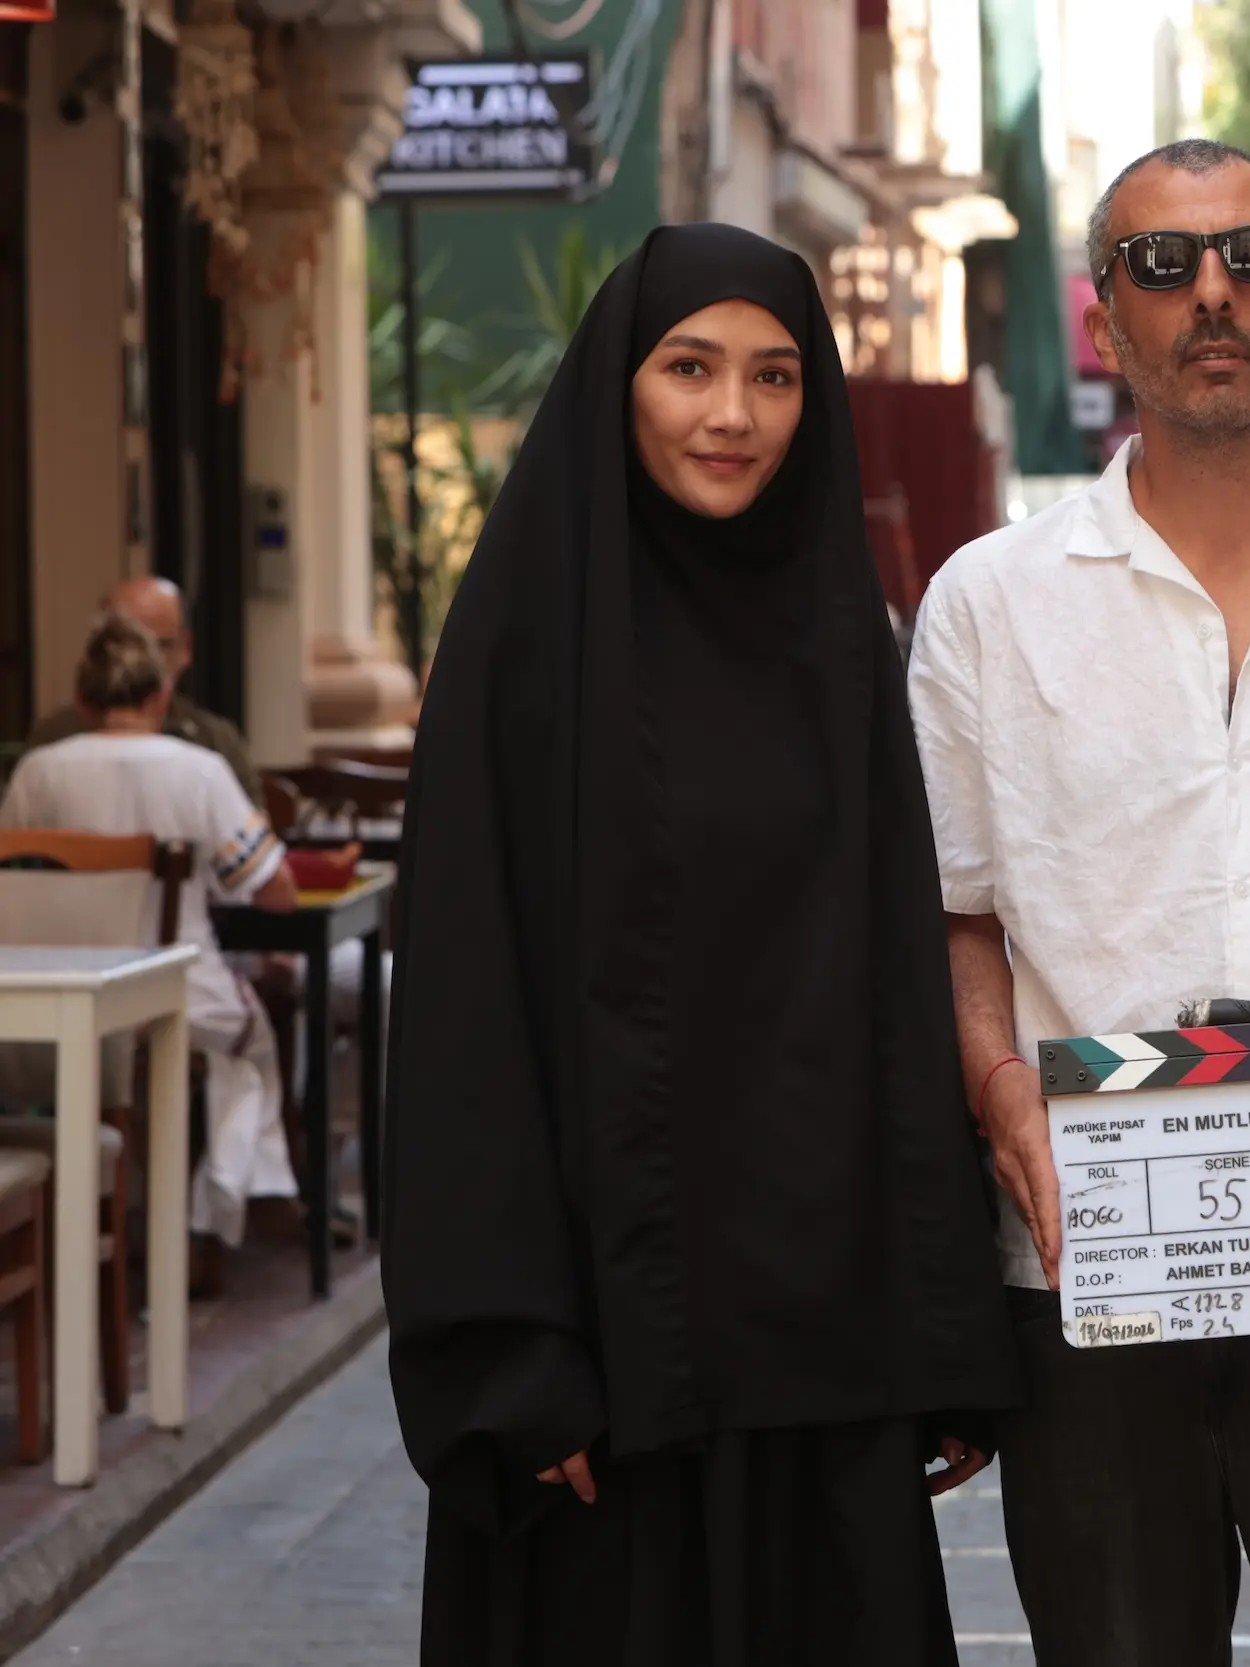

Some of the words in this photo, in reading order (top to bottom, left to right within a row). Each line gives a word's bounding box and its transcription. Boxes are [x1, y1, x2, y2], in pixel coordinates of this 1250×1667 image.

[1062, 1121, 1107, 1134] AYBÜKE
[1109, 1119, 1146, 1131] PUSAT
[1162, 1116, 1189, 1133] EN
[1087, 1133, 1122, 1144] YAPIM
[1204, 1155, 1250, 1171] SCENE
[1088, 1166, 1119, 1180] ROLL
[1198, 1177, 1247, 1222] 55
[1164, 1239, 1223, 1258] ERKAN
[1166, 1263, 1226, 1281] AHMET
[1170, 1317, 1194, 1332] Fps
